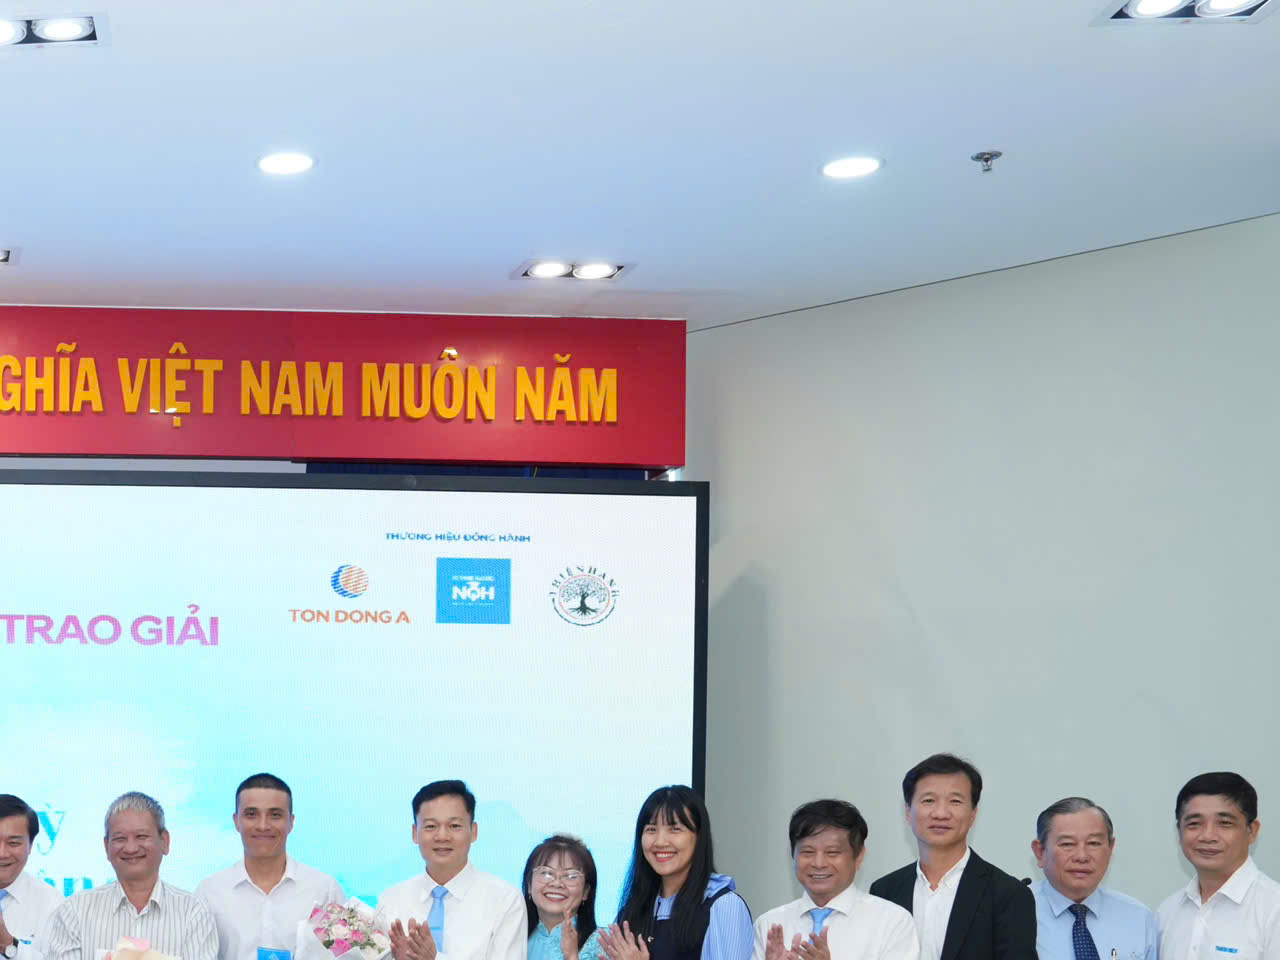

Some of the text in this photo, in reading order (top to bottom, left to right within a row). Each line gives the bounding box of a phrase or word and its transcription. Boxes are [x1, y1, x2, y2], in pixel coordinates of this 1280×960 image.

[117, 341, 224, 428] VIỆT
[240, 359, 345, 417] NAM
[361, 346, 497, 421] MUÔN
[513, 353, 618, 423] NĂM
[130, 603, 220, 646] GIẢI
